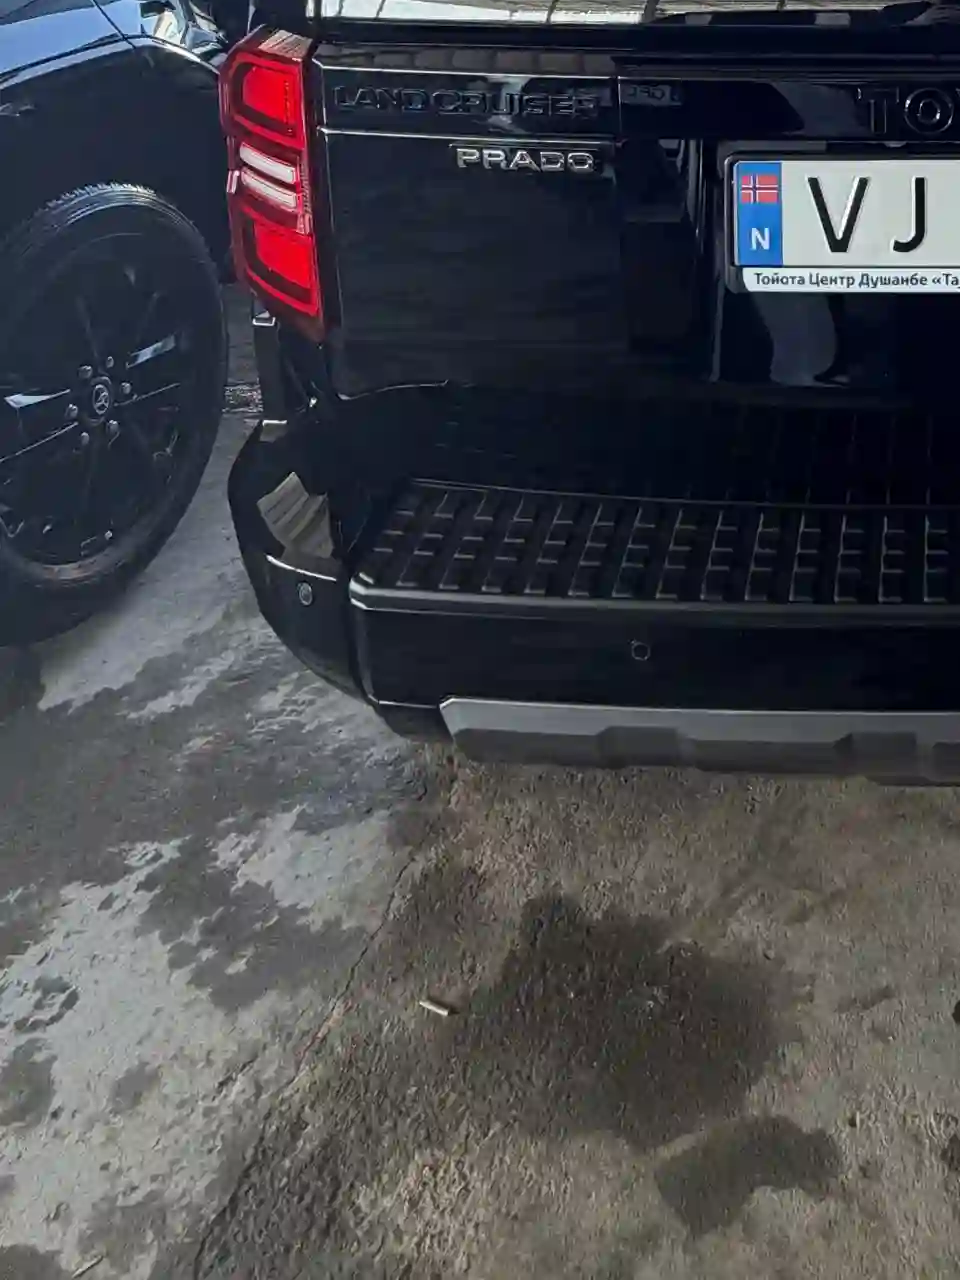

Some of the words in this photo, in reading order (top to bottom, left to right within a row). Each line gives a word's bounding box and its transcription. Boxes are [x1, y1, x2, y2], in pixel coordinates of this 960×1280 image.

[334, 86, 430, 112] LAND
[433, 89, 601, 118] CRUISER
[457, 147, 595, 173] PRADO
[750, 227, 771, 251] N
[754, 272, 806, 286] Тойота
[809, 273, 855, 290] Центр
[858, 273, 928, 289] Душанбе
